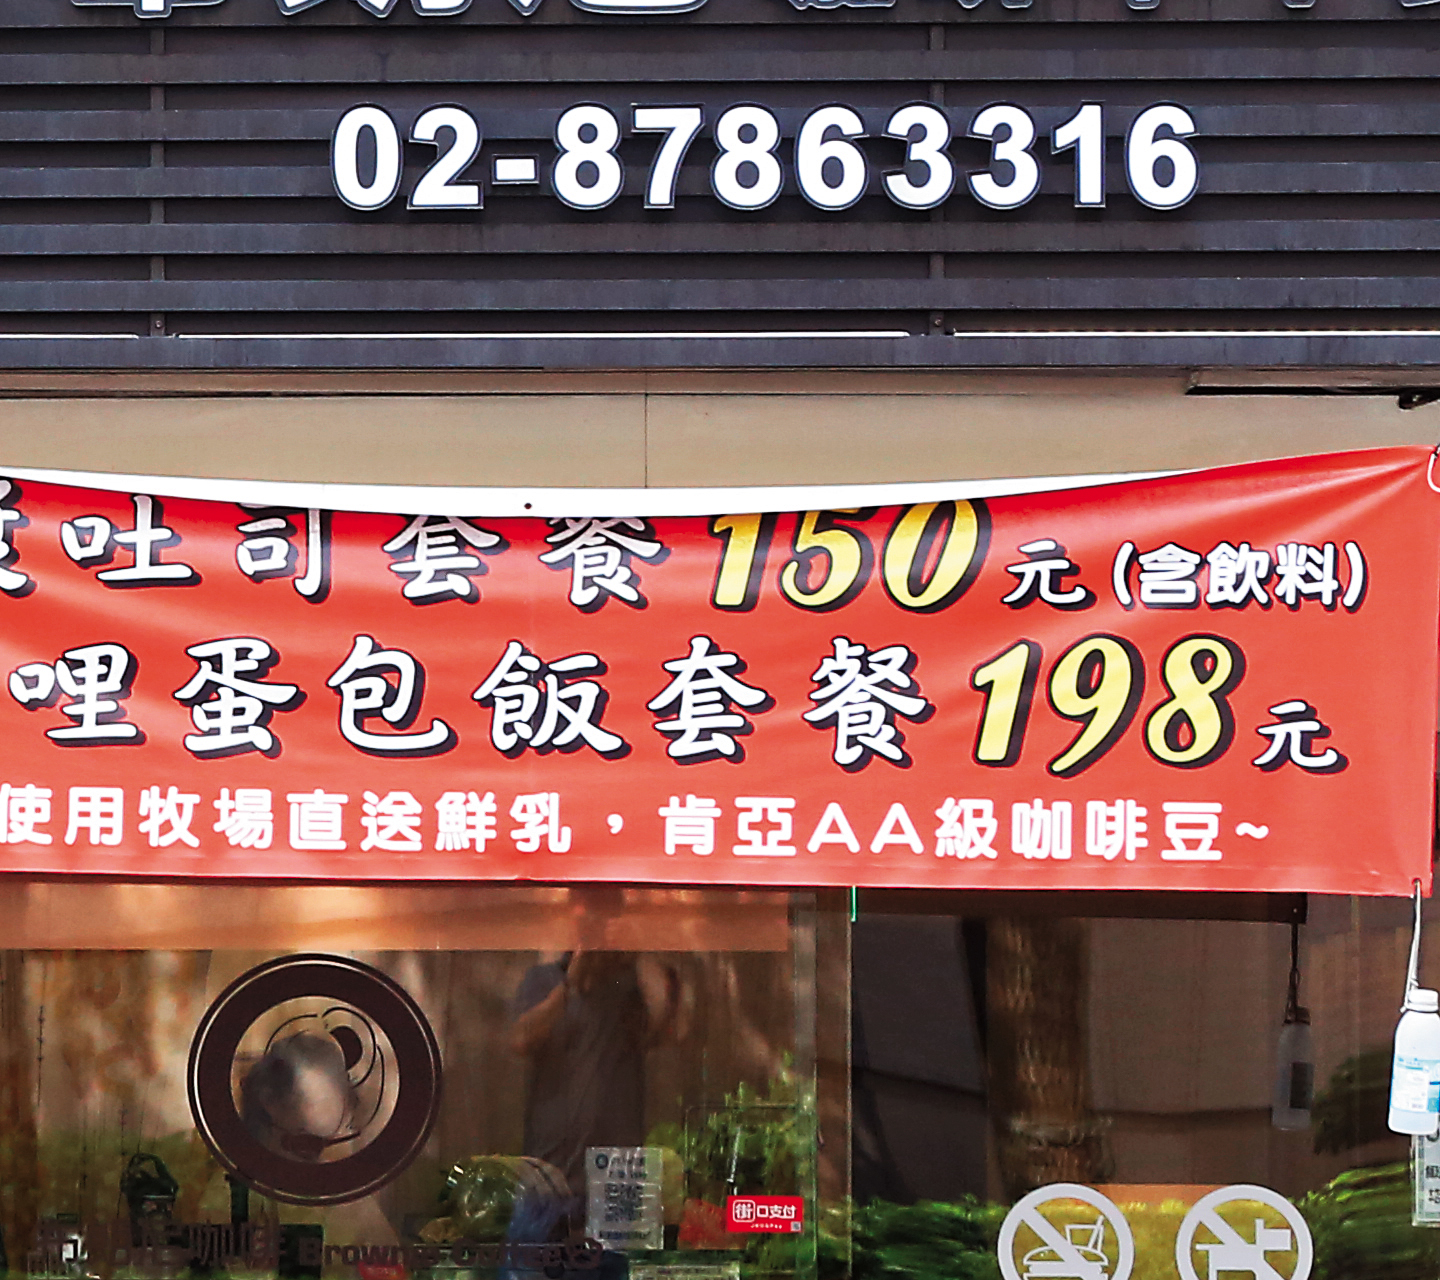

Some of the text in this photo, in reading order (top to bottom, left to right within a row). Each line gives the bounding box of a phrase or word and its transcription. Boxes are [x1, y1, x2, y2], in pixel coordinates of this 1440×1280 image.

[332, 104, 1199, 210] 02-87863316
[734, 1203, 797, 1219] 街口支付
